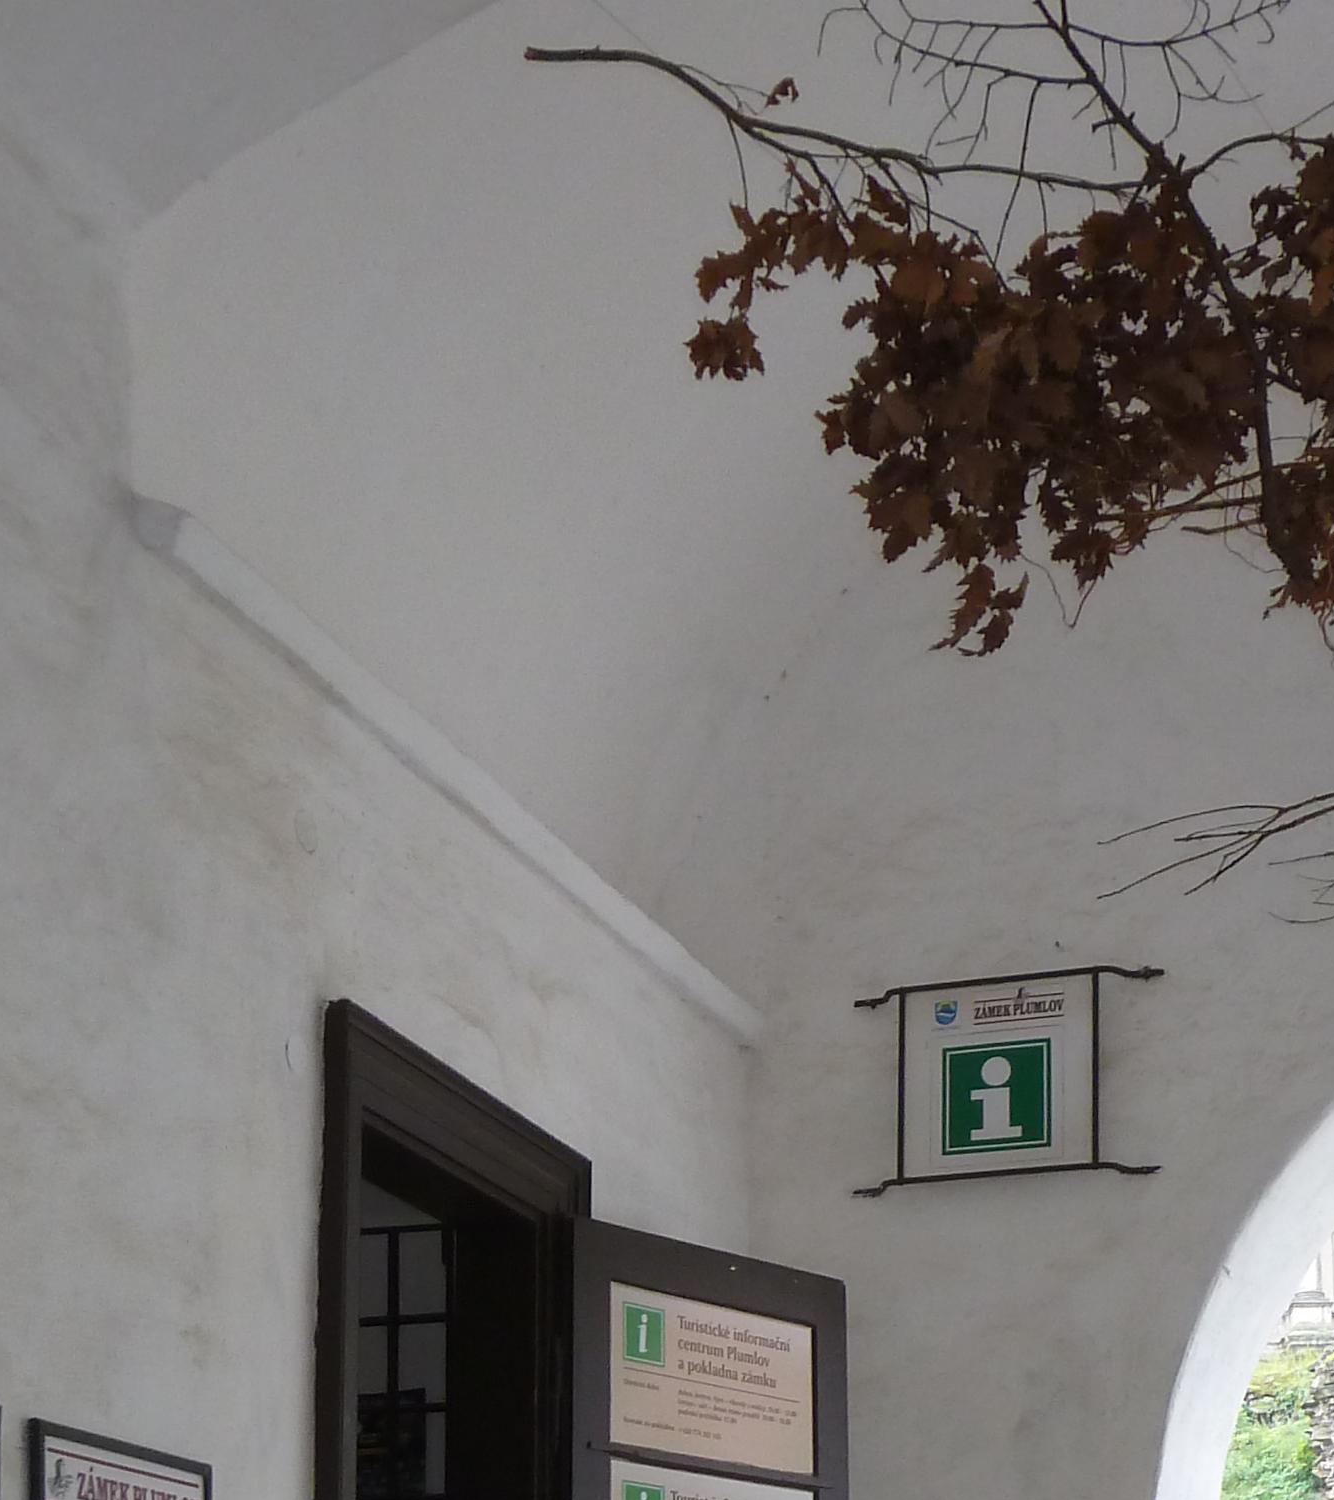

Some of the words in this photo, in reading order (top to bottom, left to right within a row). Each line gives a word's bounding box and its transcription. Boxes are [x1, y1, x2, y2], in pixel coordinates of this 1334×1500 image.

[974, 1001, 1011, 1020] ZÁMEK
[1013, 999, 1065, 1016] PLUMLOV
[677, 1315, 731, 1339] Turistické
[733, 1329, 792, 1353] informační
[677, 1337, 725, 1359] centrum
[727, 1346, 771, 1368] Plumlov
[677, 1358, 685, 1371] a
[687, 1360, 739, 1382] pokladna
[741, 1371, 778, 1390] zámku
